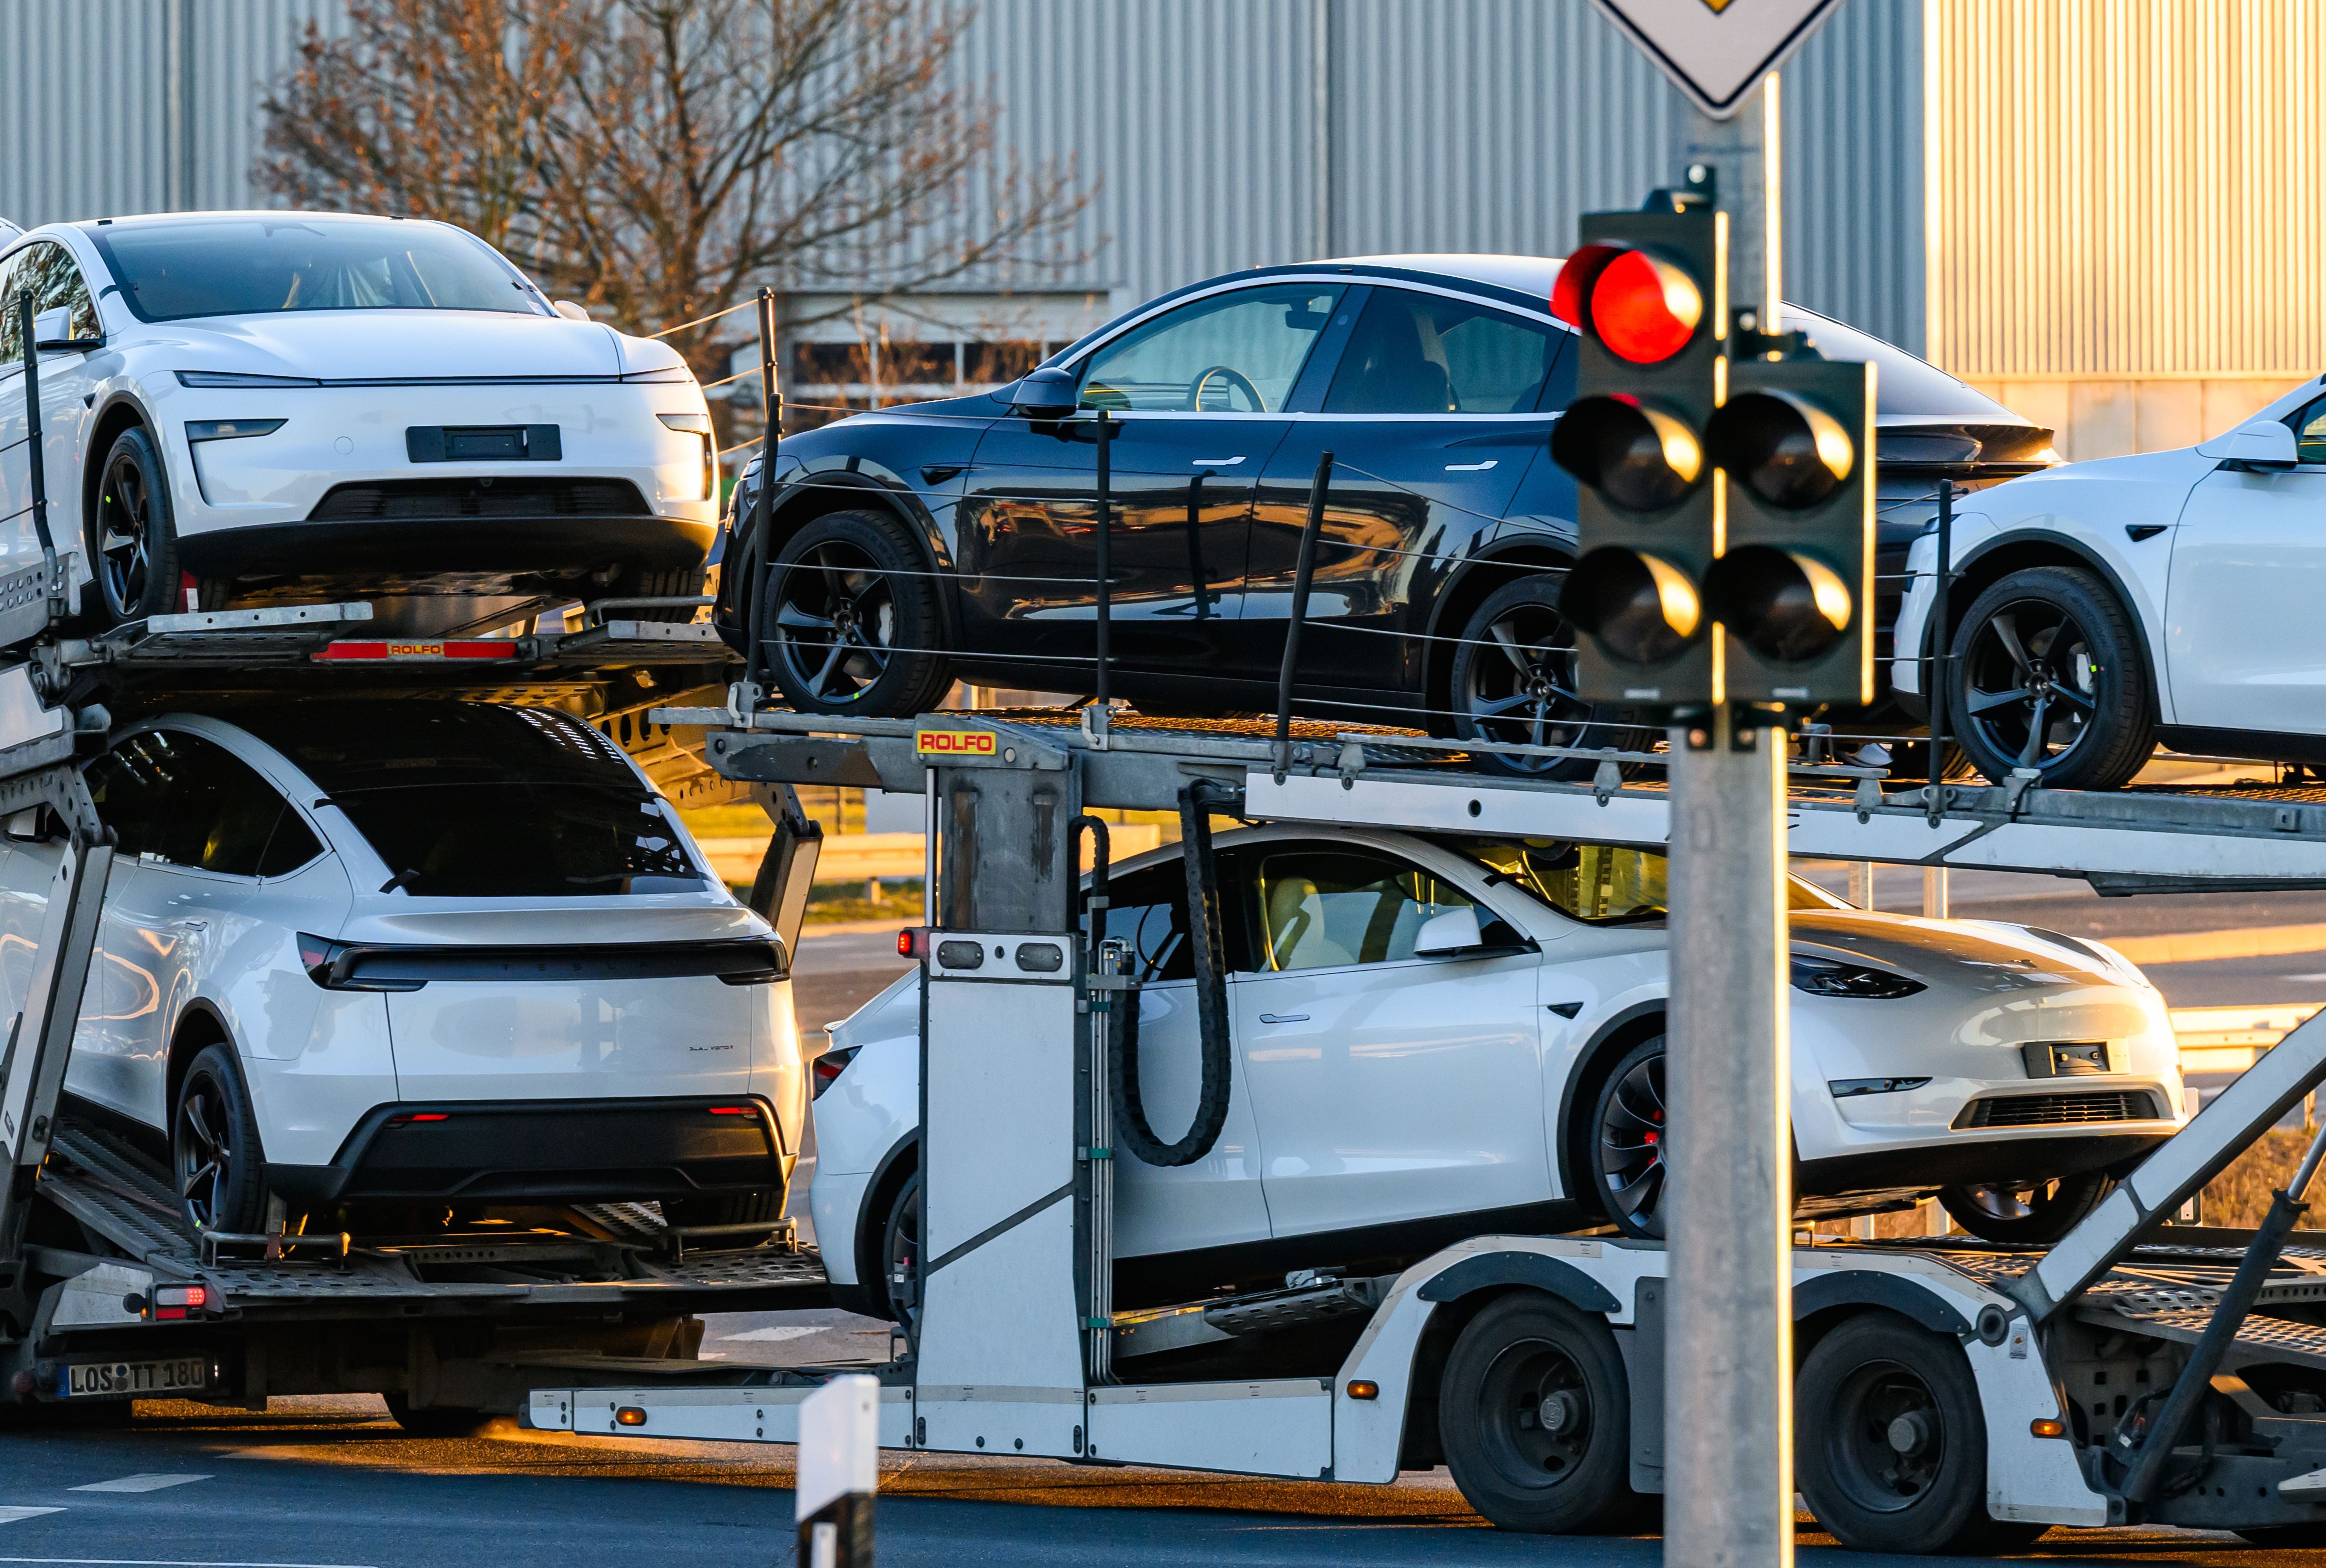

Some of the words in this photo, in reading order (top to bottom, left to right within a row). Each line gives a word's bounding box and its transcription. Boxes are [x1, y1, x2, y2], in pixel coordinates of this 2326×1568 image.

[391, 645, 441, 654] ROLFO
[920, 734, 992, 751] ROLFO
[71, 1366, 113, 1393] LOS
[129, 1364, 156, 1389] TT
[163, 1359, 200, 1387] 180
